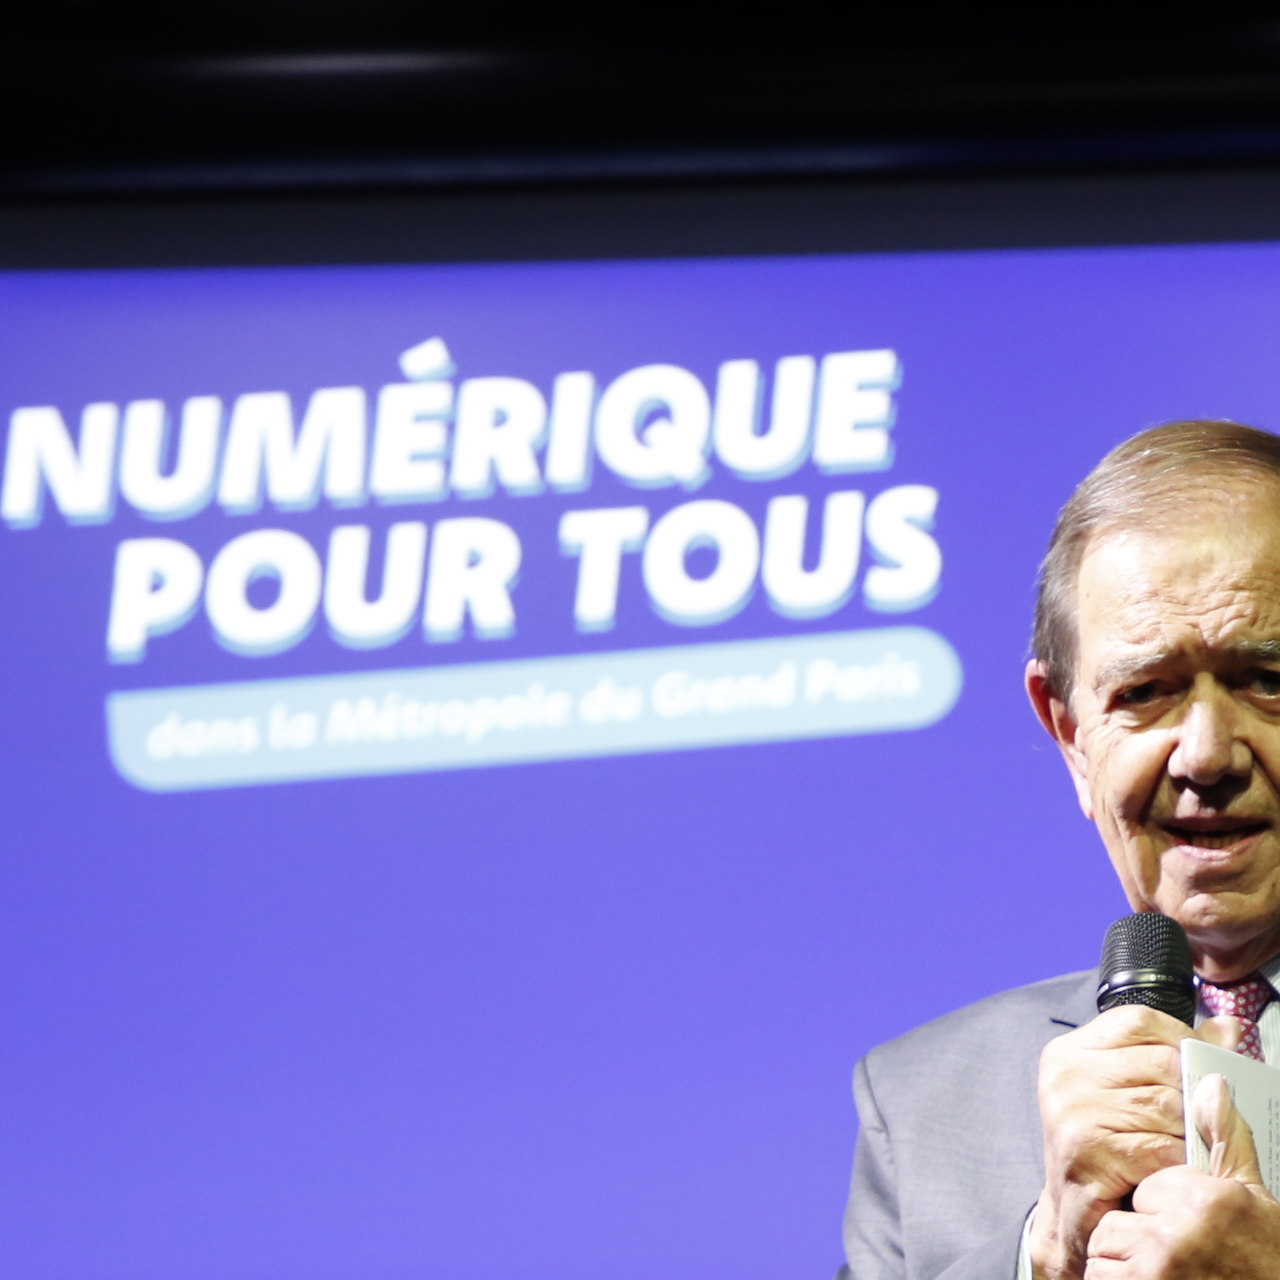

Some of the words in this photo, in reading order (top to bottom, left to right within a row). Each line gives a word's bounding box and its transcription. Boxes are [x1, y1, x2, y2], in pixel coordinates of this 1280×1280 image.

[0, 336, 900, 528] NUMÉRIQUE
[107, 516, 521, 663] POUR
[558, 484, 942, 633] TOUS
[146, 711, 260, 759] dans
[269, 703, 318, 750] la
[326, 683, 572, 746] Métropole
[579, 676, 645, 726] du
[652, 661, 797, 718] Grand
[804, 651, 923, 706] Paris
